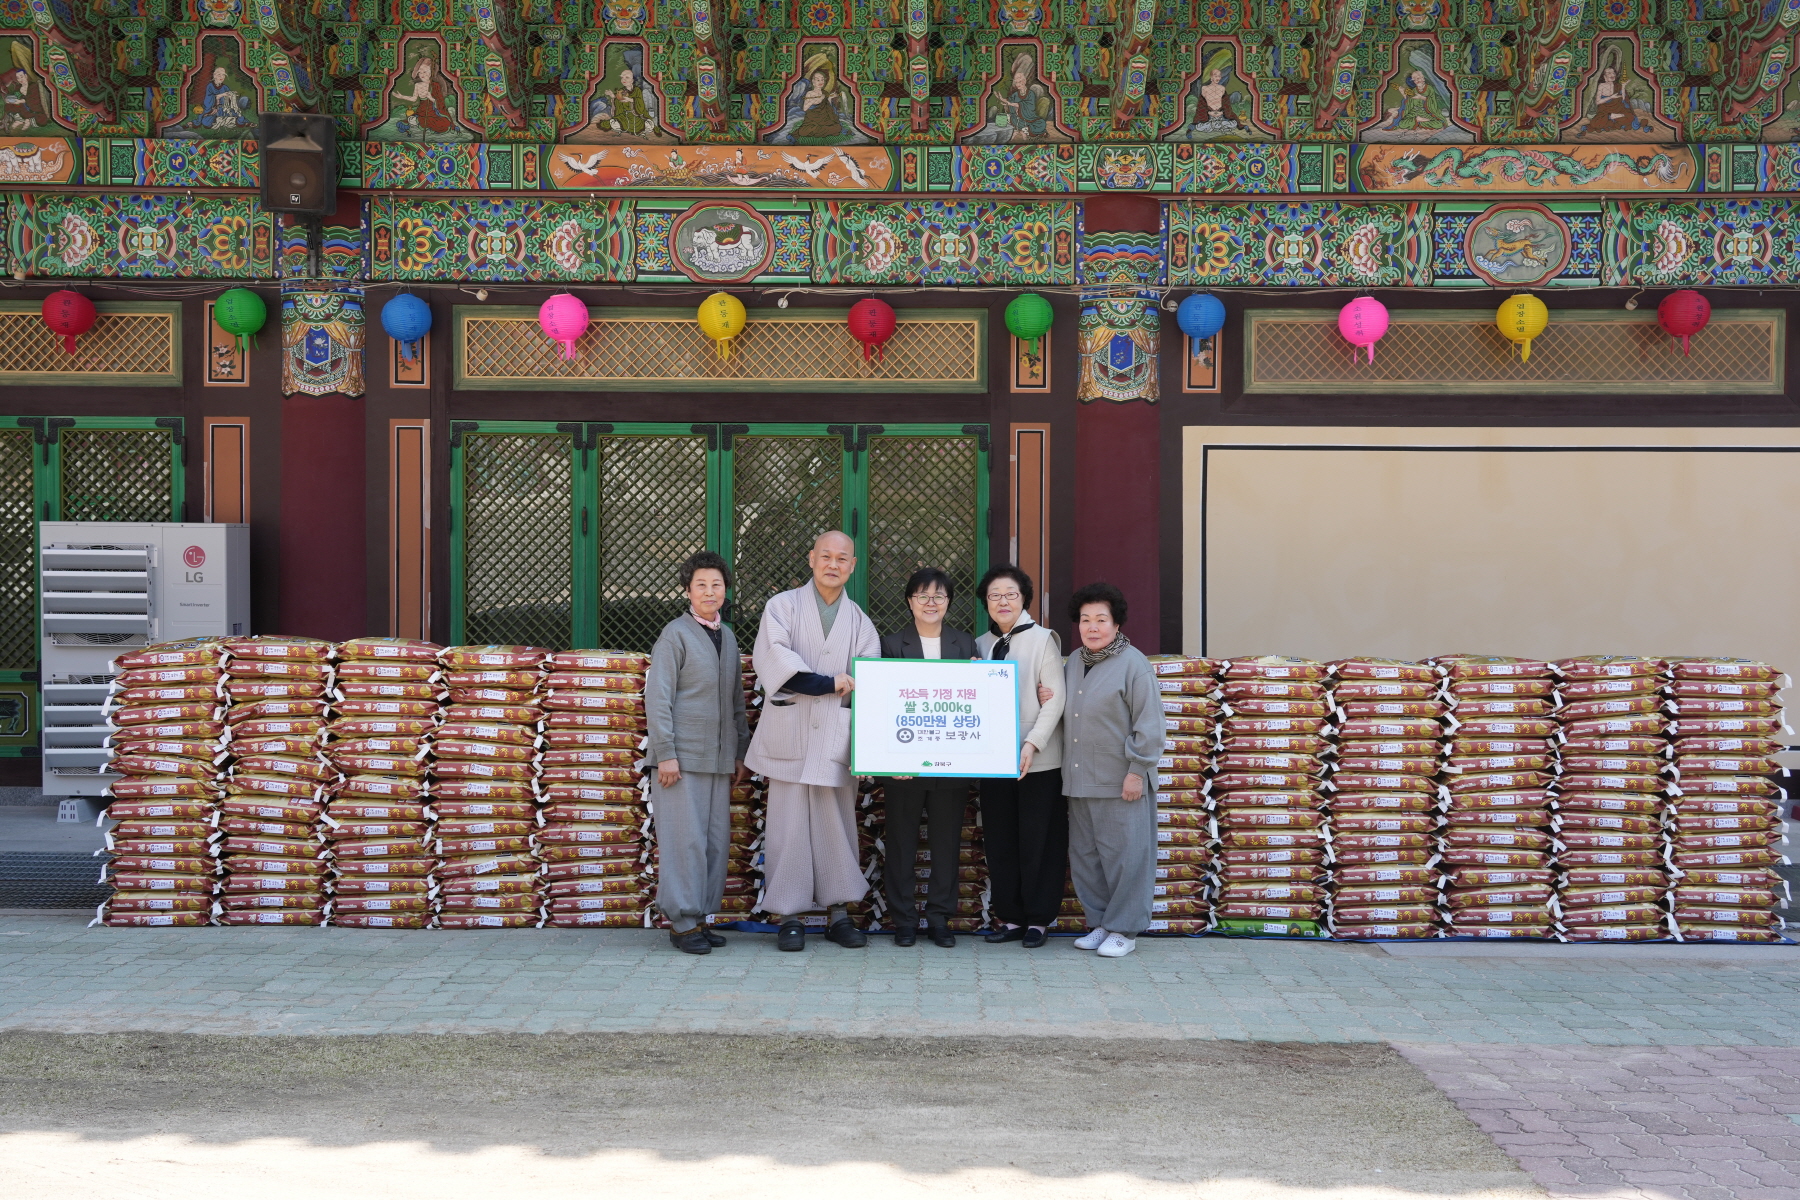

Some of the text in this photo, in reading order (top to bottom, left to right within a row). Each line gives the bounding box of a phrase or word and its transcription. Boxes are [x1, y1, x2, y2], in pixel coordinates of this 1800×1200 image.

[185, 571, 204, 583] LG
[899, 688, 977, 700] 저소득 가정 지원
[904, 701, 972, 714] 쌀 3,000kg
[896, 715, 981, 728] (850만원 상당)
[945, 731, 981, 740] 보광사
